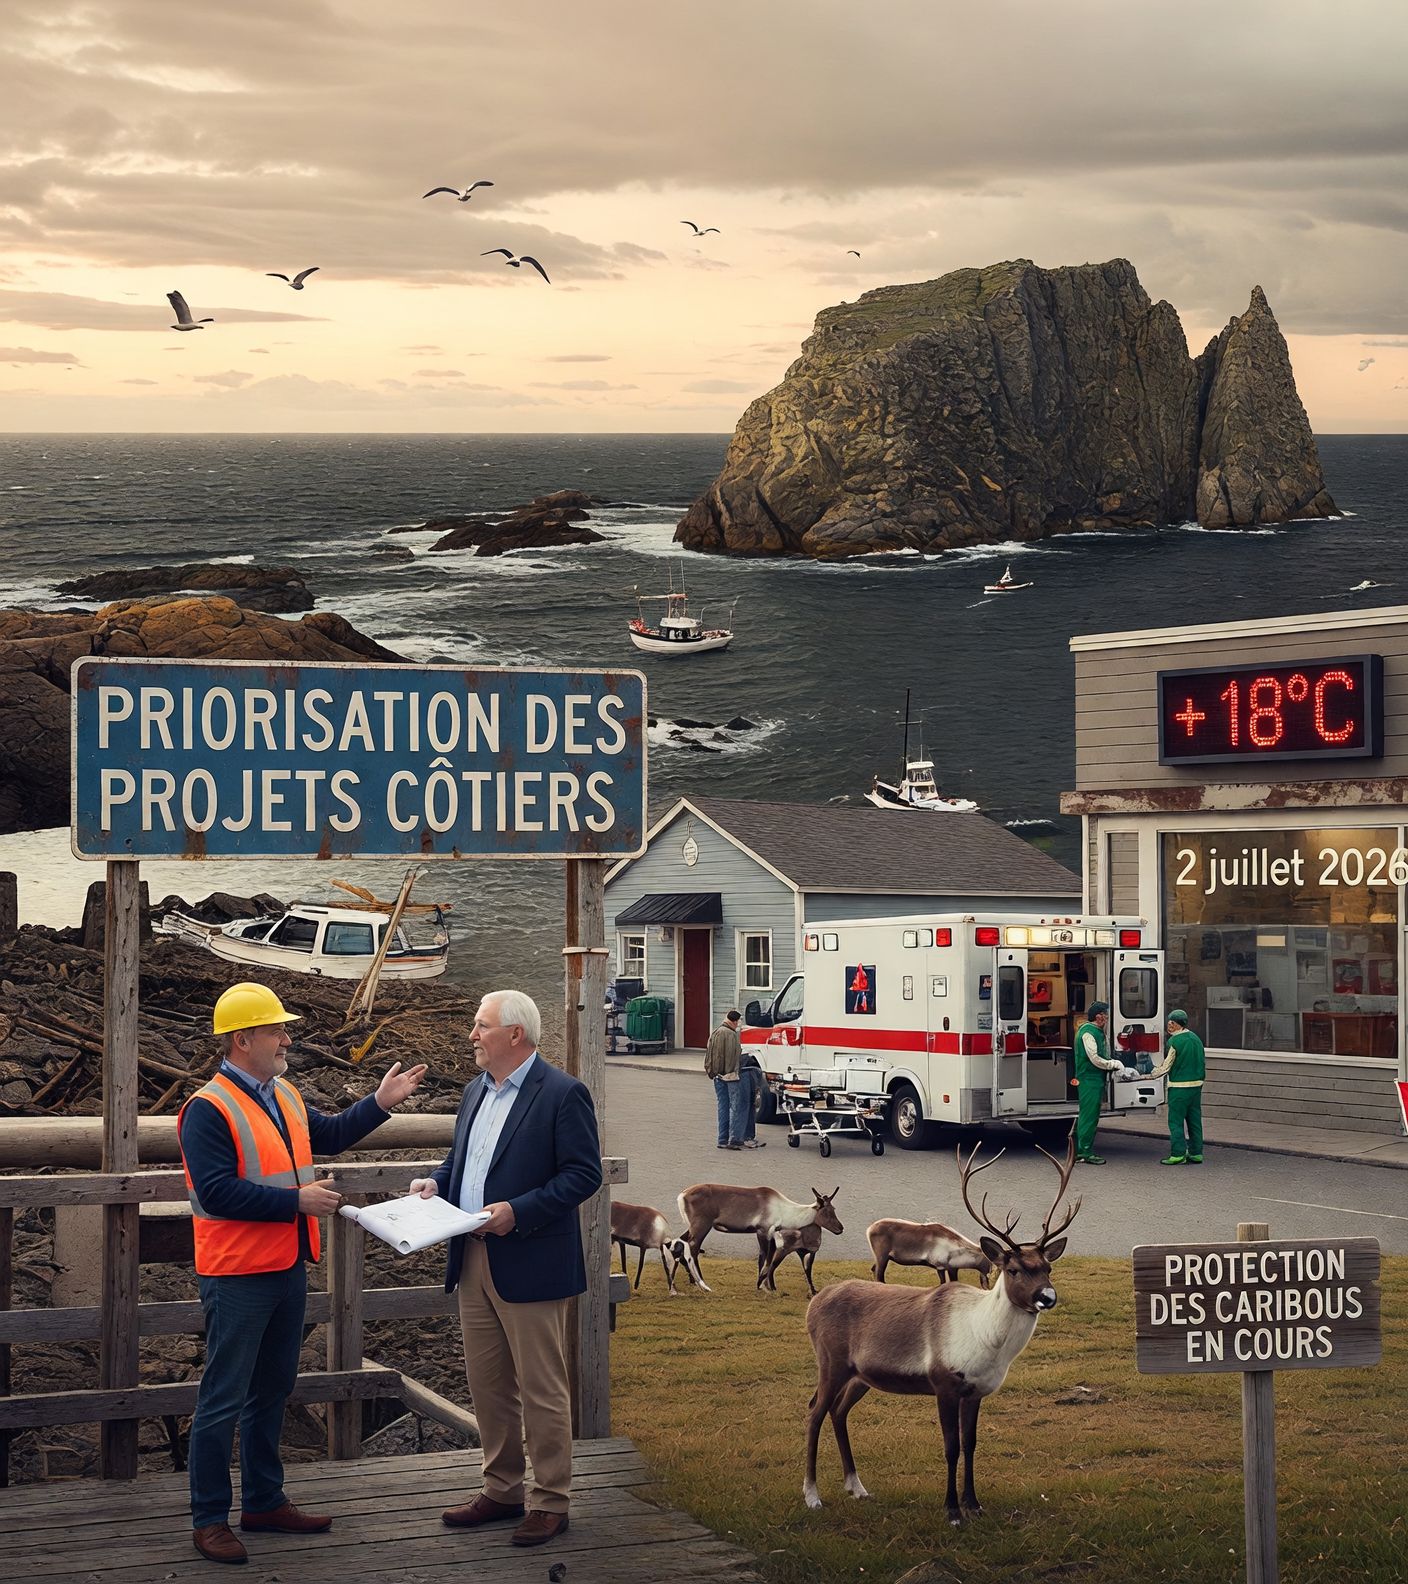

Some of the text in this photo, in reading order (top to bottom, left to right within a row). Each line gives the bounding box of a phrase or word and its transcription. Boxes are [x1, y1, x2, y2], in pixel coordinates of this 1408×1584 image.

[98, 685, 627, 756] PRIORISATION DES
[1175, 671, 1355, 747] +18°C
[100, 756, 616, 833] PROJETS CÔTIERS
[1175, 848, 1198, 886] 2
[1204, 847, 1306, 895] juillet
[1165, 1248, 1345, 1287] PROTECTION
[1150, 1286, 1363, 1325] DES CARIBOUS
[1187, 1325, 1333, 1362] EN COURS
